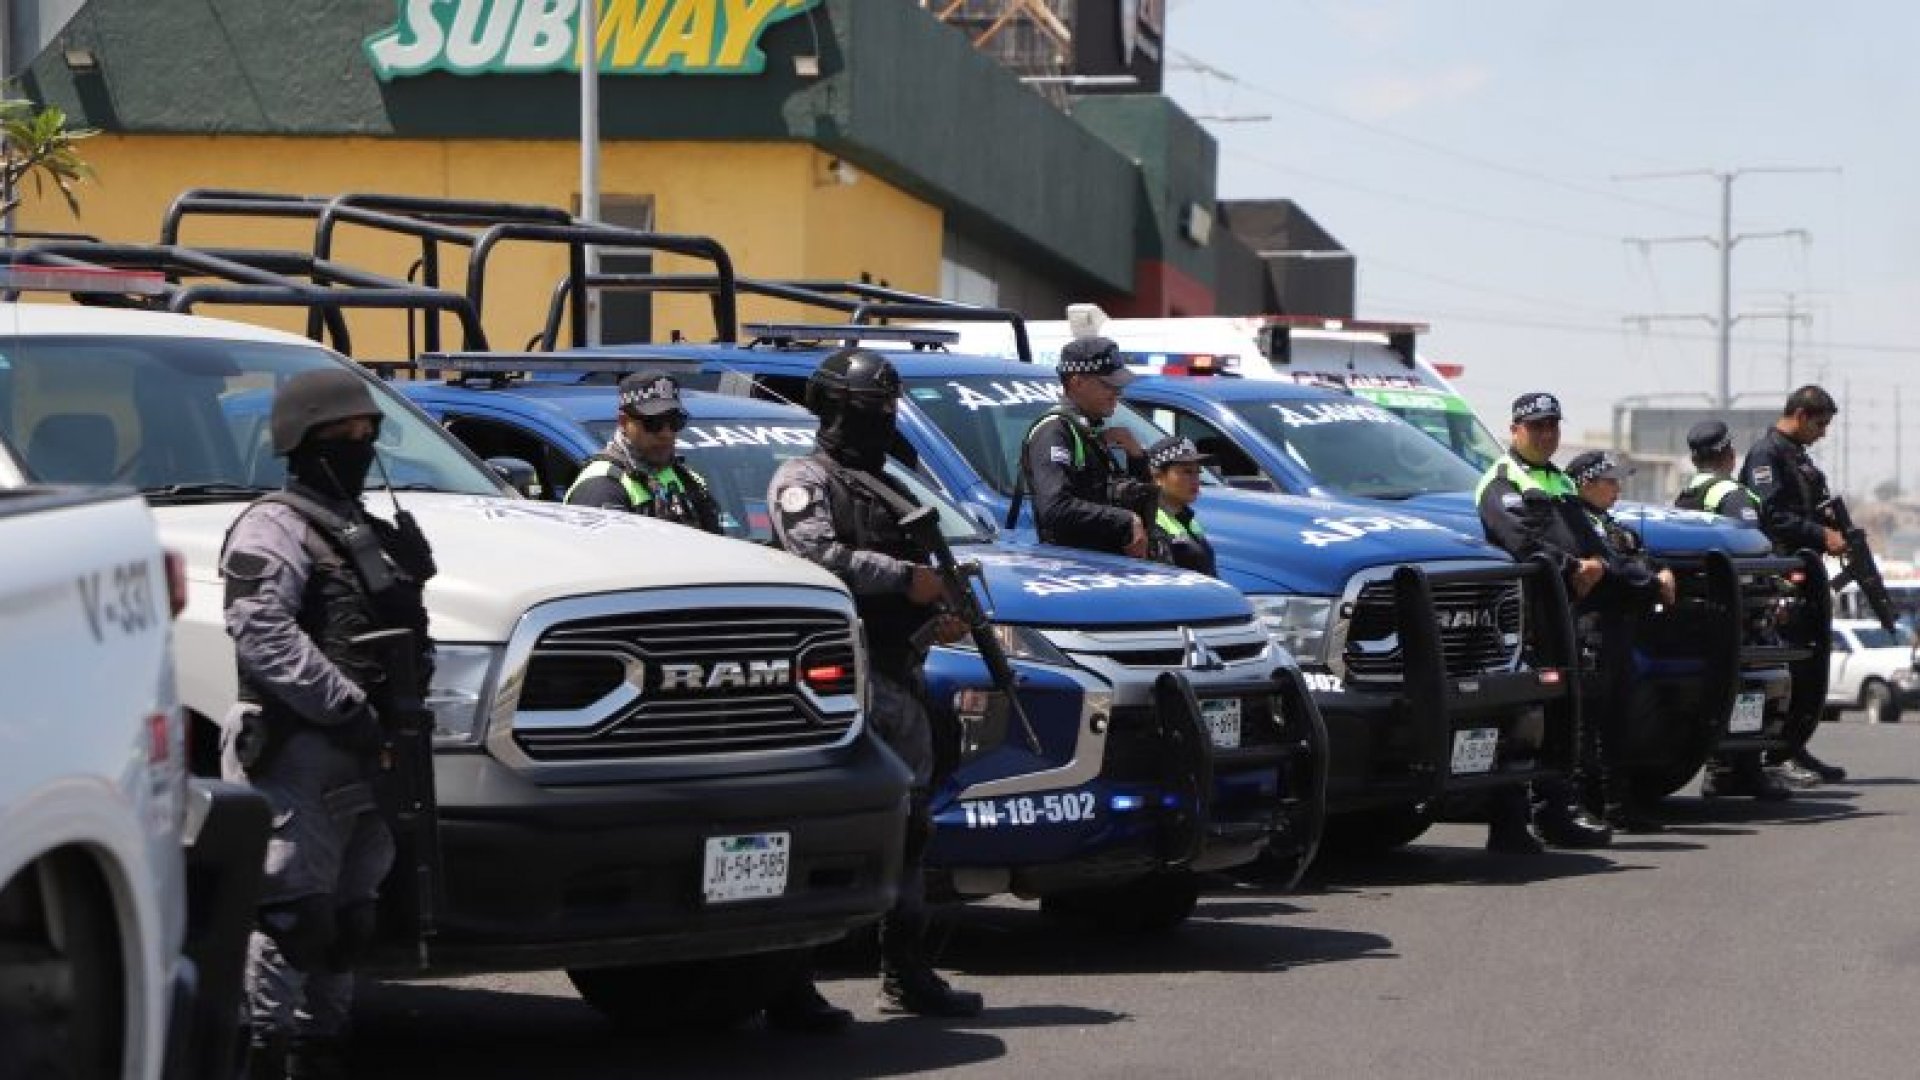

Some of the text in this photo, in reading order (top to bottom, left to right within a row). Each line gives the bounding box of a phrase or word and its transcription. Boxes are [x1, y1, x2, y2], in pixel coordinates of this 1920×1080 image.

[369, 0, 800, 68] SUBWAY
[660, 660, 790, 688] RAM
[960, 793, 1096, 828] TN-18-502
